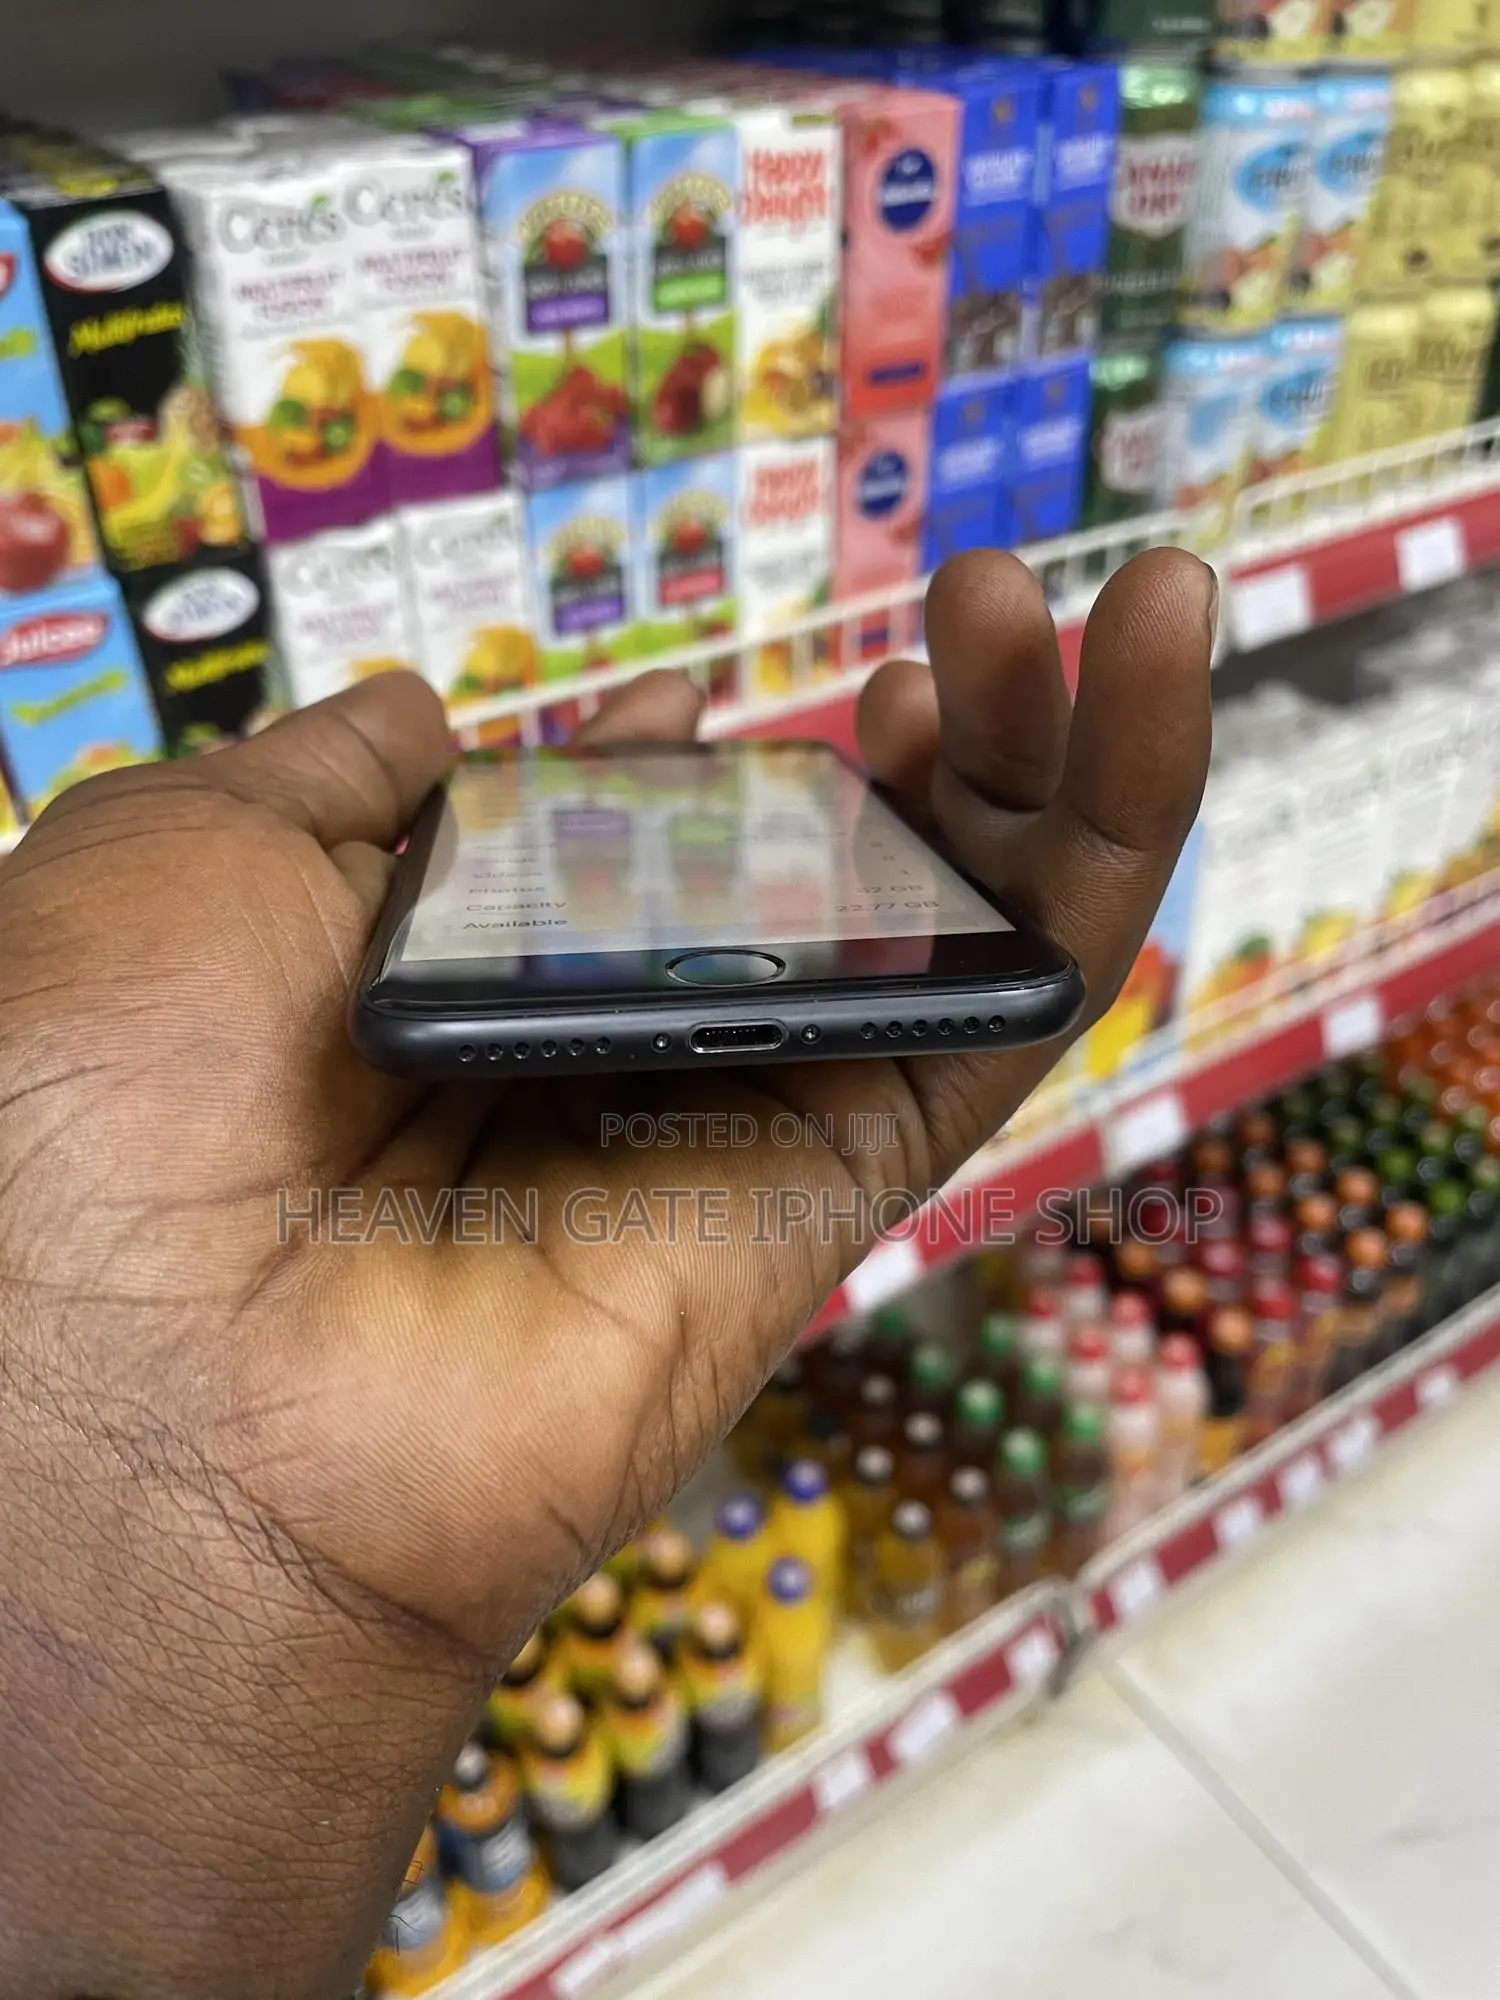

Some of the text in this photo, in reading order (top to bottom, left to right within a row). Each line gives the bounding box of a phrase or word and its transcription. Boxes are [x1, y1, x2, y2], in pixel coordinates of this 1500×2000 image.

[462, 920, 569, 930] Available
[904, 900, 940, 909] GB
[466, 901, 567, 914] Capacity
